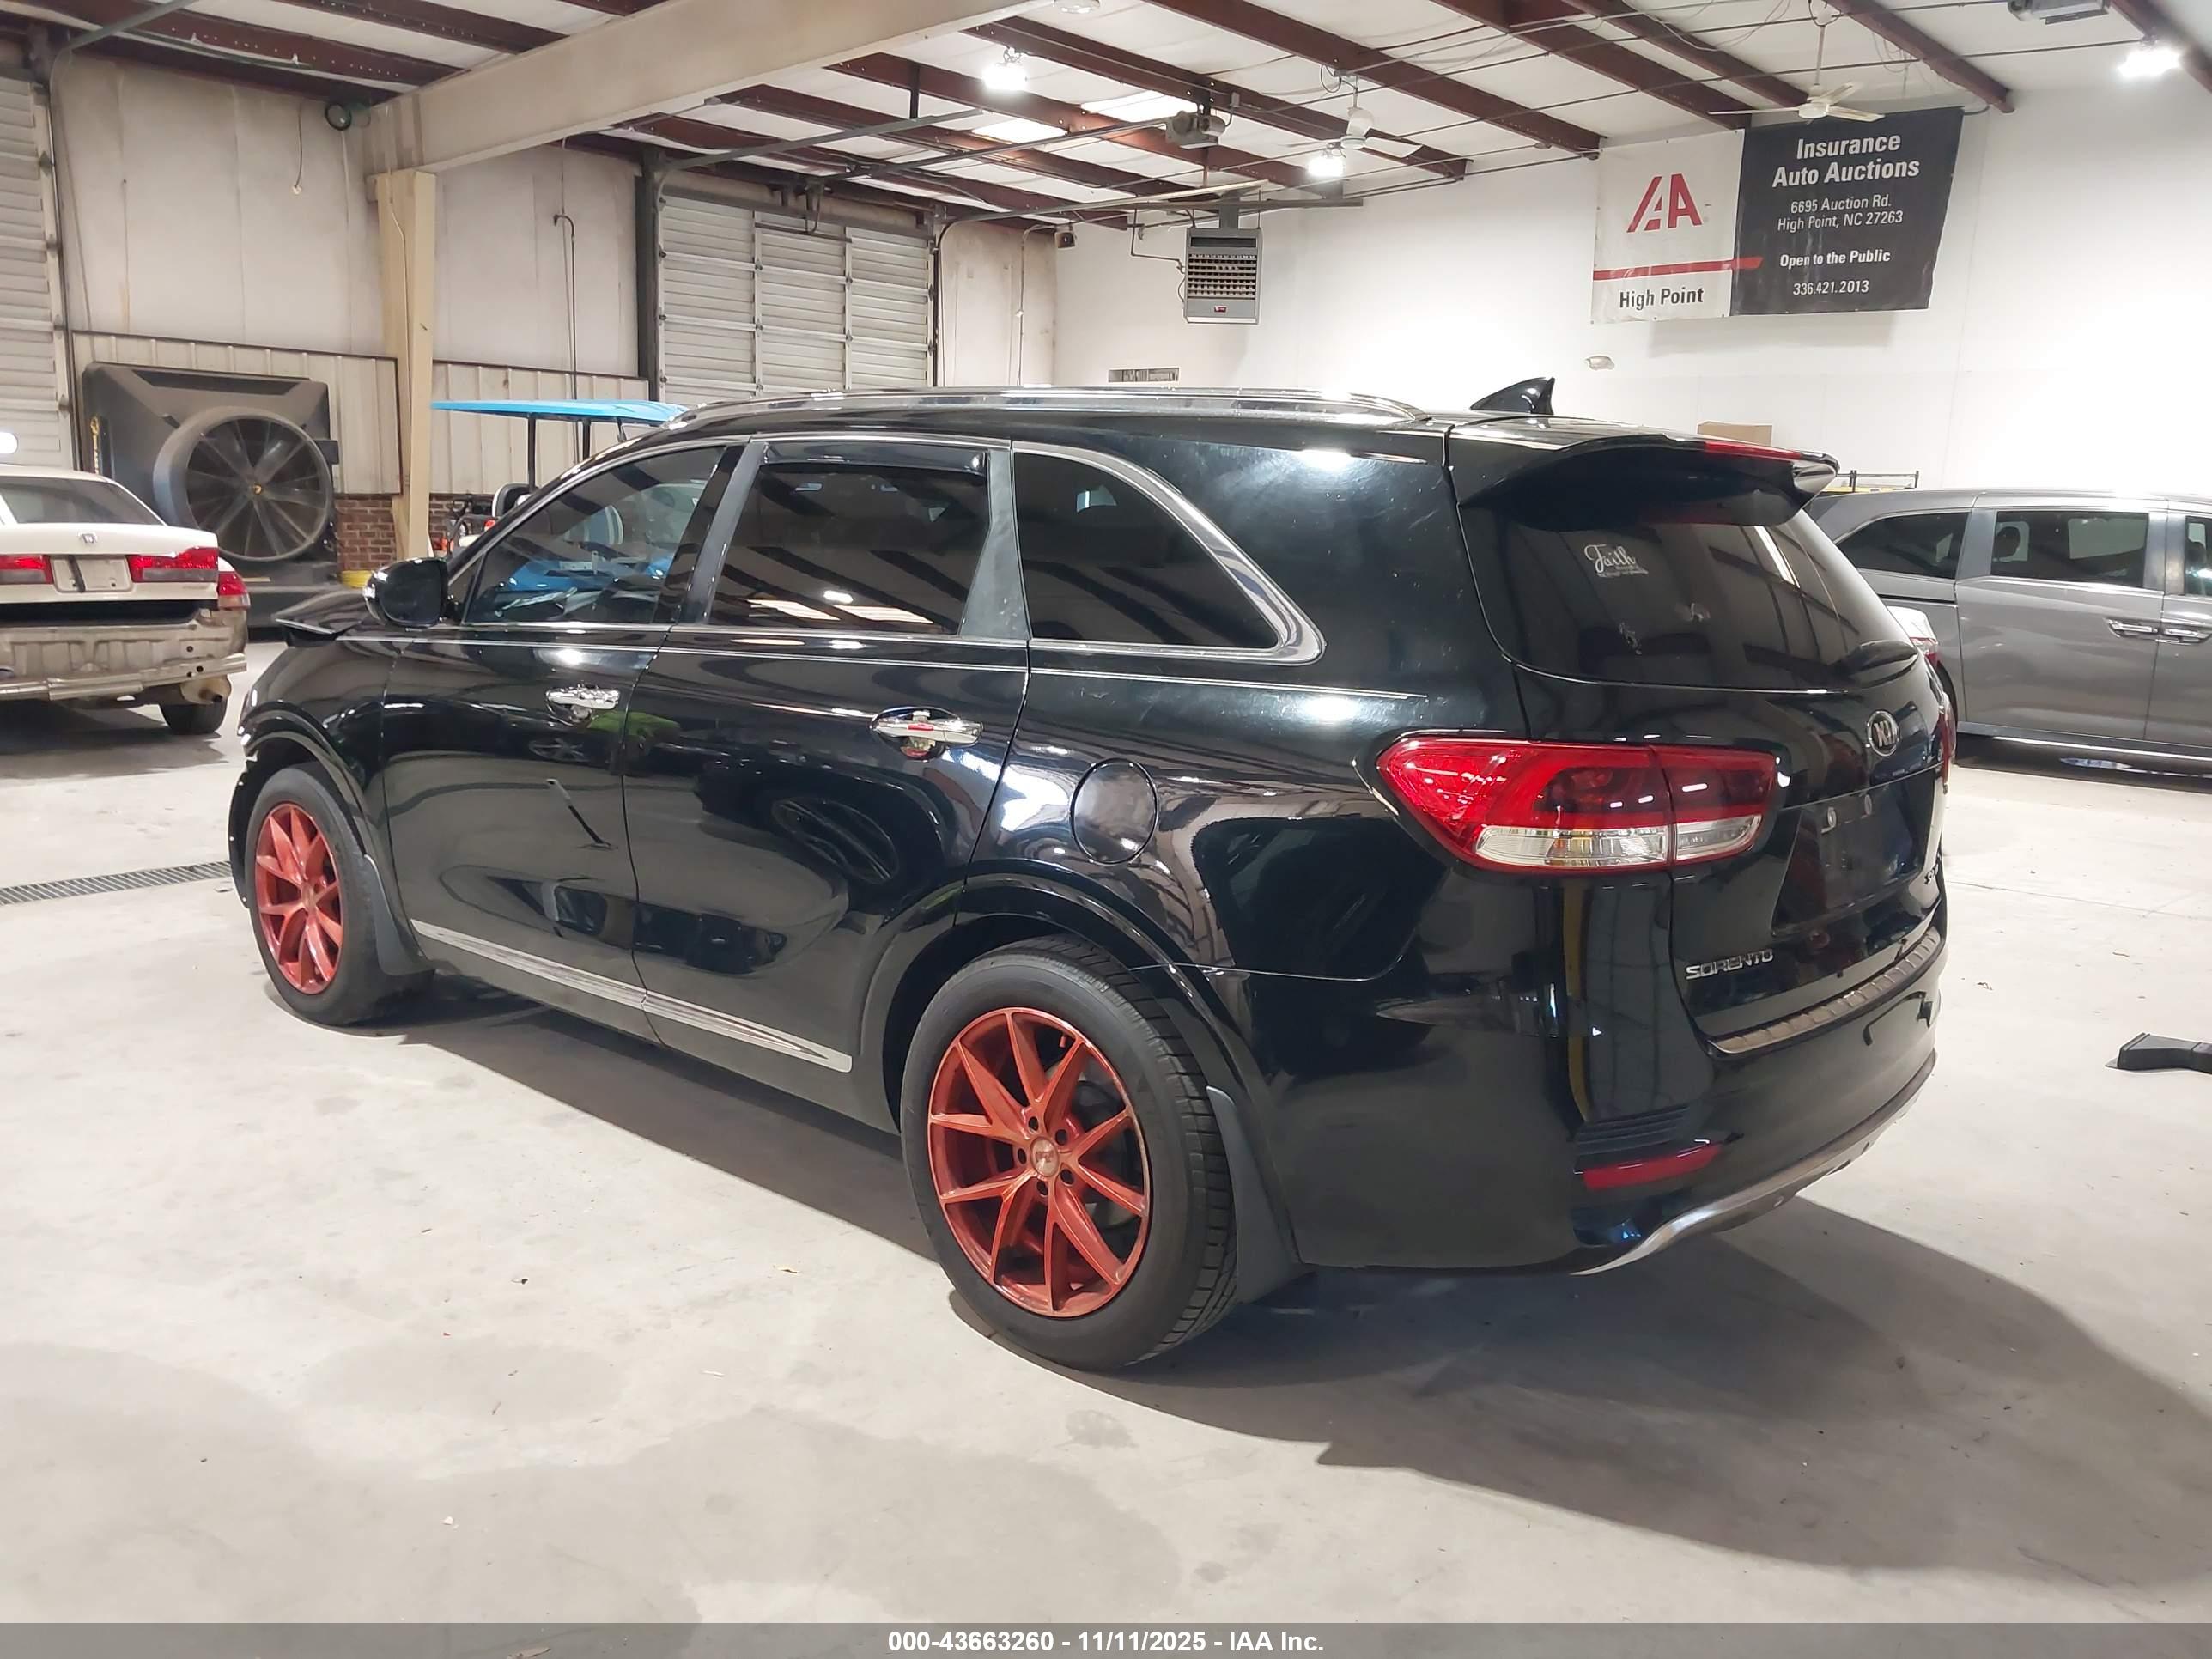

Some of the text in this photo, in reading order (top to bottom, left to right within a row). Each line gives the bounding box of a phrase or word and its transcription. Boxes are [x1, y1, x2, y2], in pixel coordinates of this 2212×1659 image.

[1796, 135, 1901, 160] Insurance
[1771, 158, 1920, 188] Auto Auctions
[1790, 193, 1892, 214] 6695 Auction Rd.
[1778, 210, 1904, 233] High Point, NC 27263
[1780, 249, 1891, 270] Open to the Public
[1620, 286, 1704, 311] High Point
[1793, 280, 1869, 295] 336.421.2013
[1686, 948, 1774, 980] SORENTO
